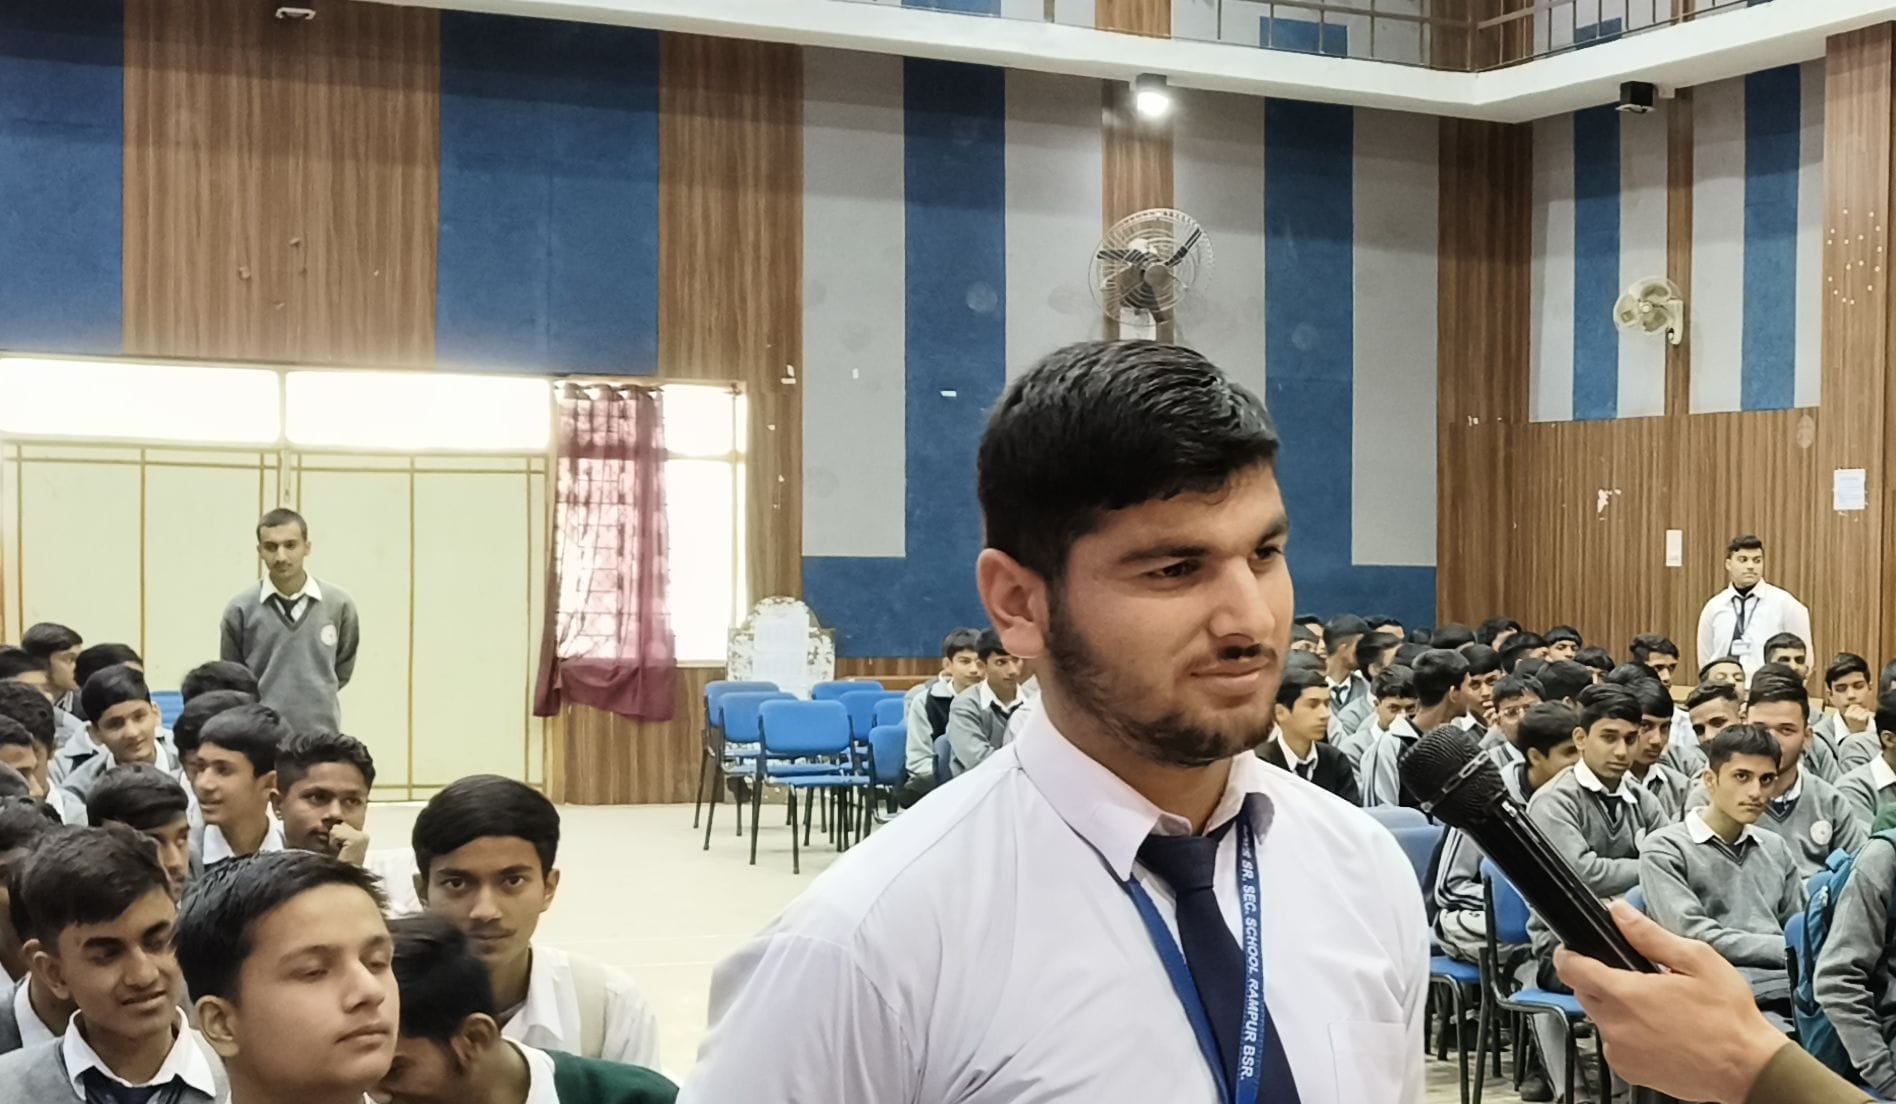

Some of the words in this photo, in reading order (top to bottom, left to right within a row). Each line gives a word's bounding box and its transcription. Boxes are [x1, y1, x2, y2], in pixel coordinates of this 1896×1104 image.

[1243, 885, 1257, 914] SEC.
[1245, 917, 1259, 974] SCHOOL
[1244, 978, 1259, 1042] RAMPUR
[1240, 1044, 1256, 1080] BSR.
